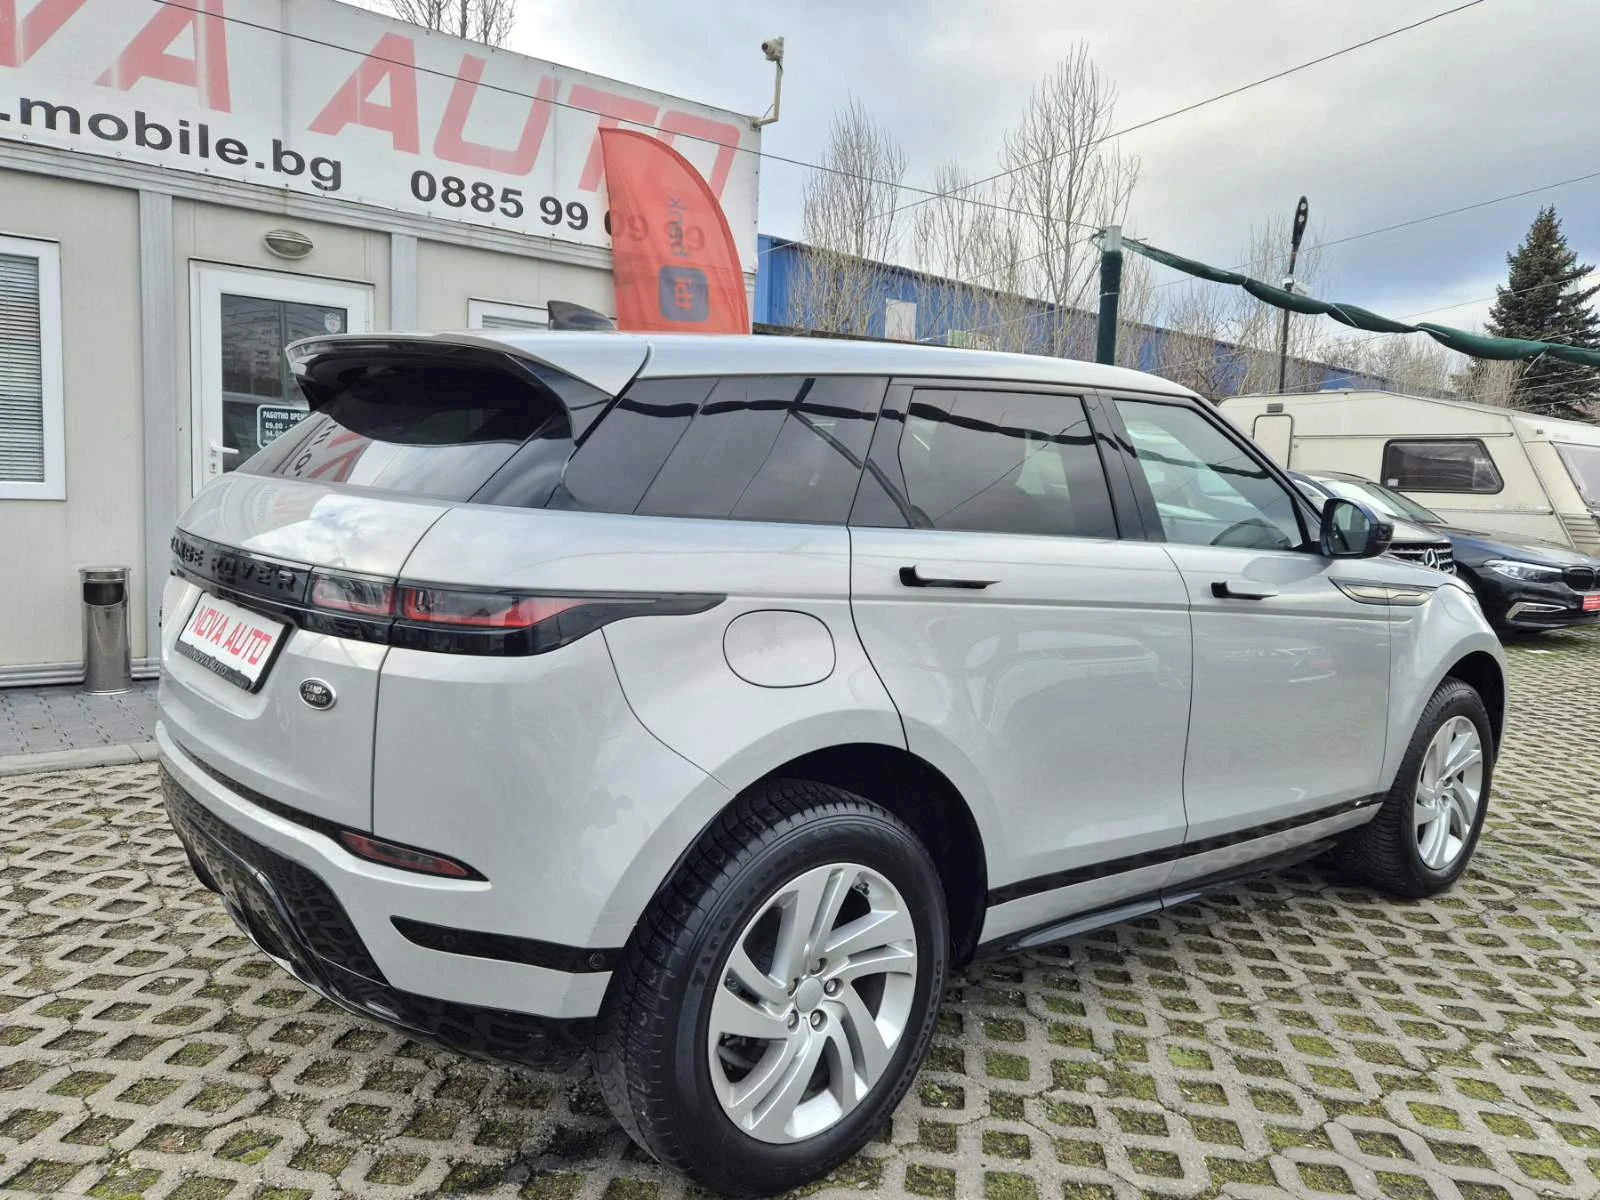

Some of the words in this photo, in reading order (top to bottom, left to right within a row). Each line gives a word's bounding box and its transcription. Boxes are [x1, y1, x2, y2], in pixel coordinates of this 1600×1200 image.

[307, 31, 740, 201] AUTO
[410, 169, 524, 218] 0885
[540, 196, 589, 231] 99
[189, 605, 230, 645] NOVA
[221, 622, 273, 666] AUTO
